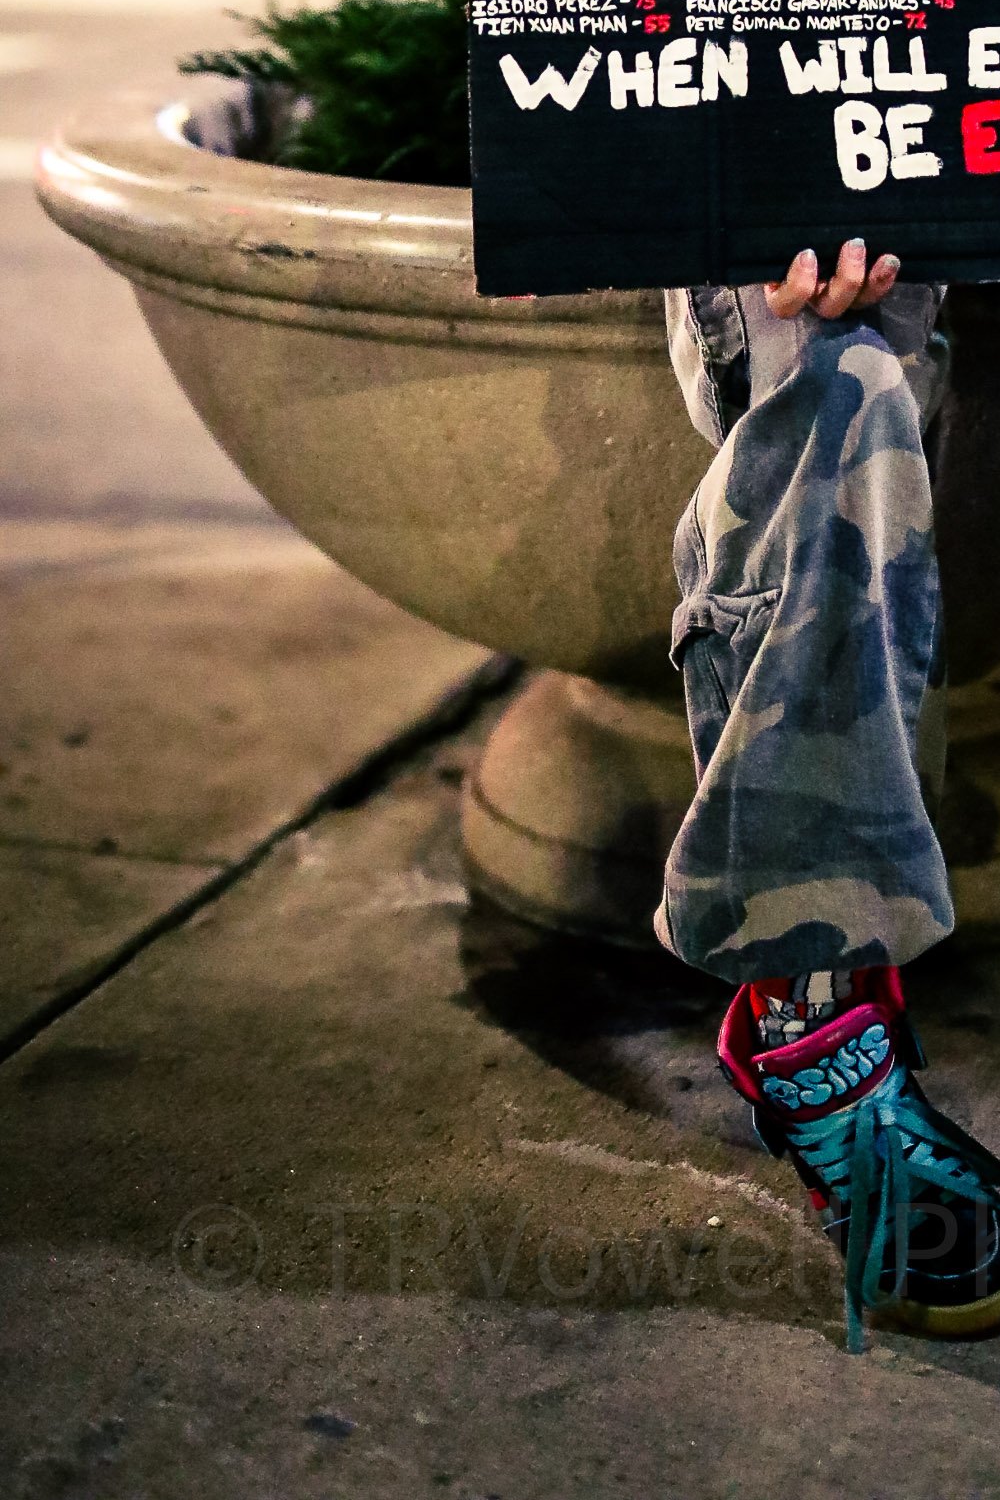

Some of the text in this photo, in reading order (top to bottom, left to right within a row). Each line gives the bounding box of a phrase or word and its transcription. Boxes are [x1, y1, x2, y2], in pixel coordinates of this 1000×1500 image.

[473, 17, 524, 36] TIEN
[528, 17, 574, 34] XUAN
[580, 15, 627, 35] PHAN
[499, 38, 748, 111] WHEN
[779, 36, 947, 94] WILL
[834, 100, 942, 190] BE
